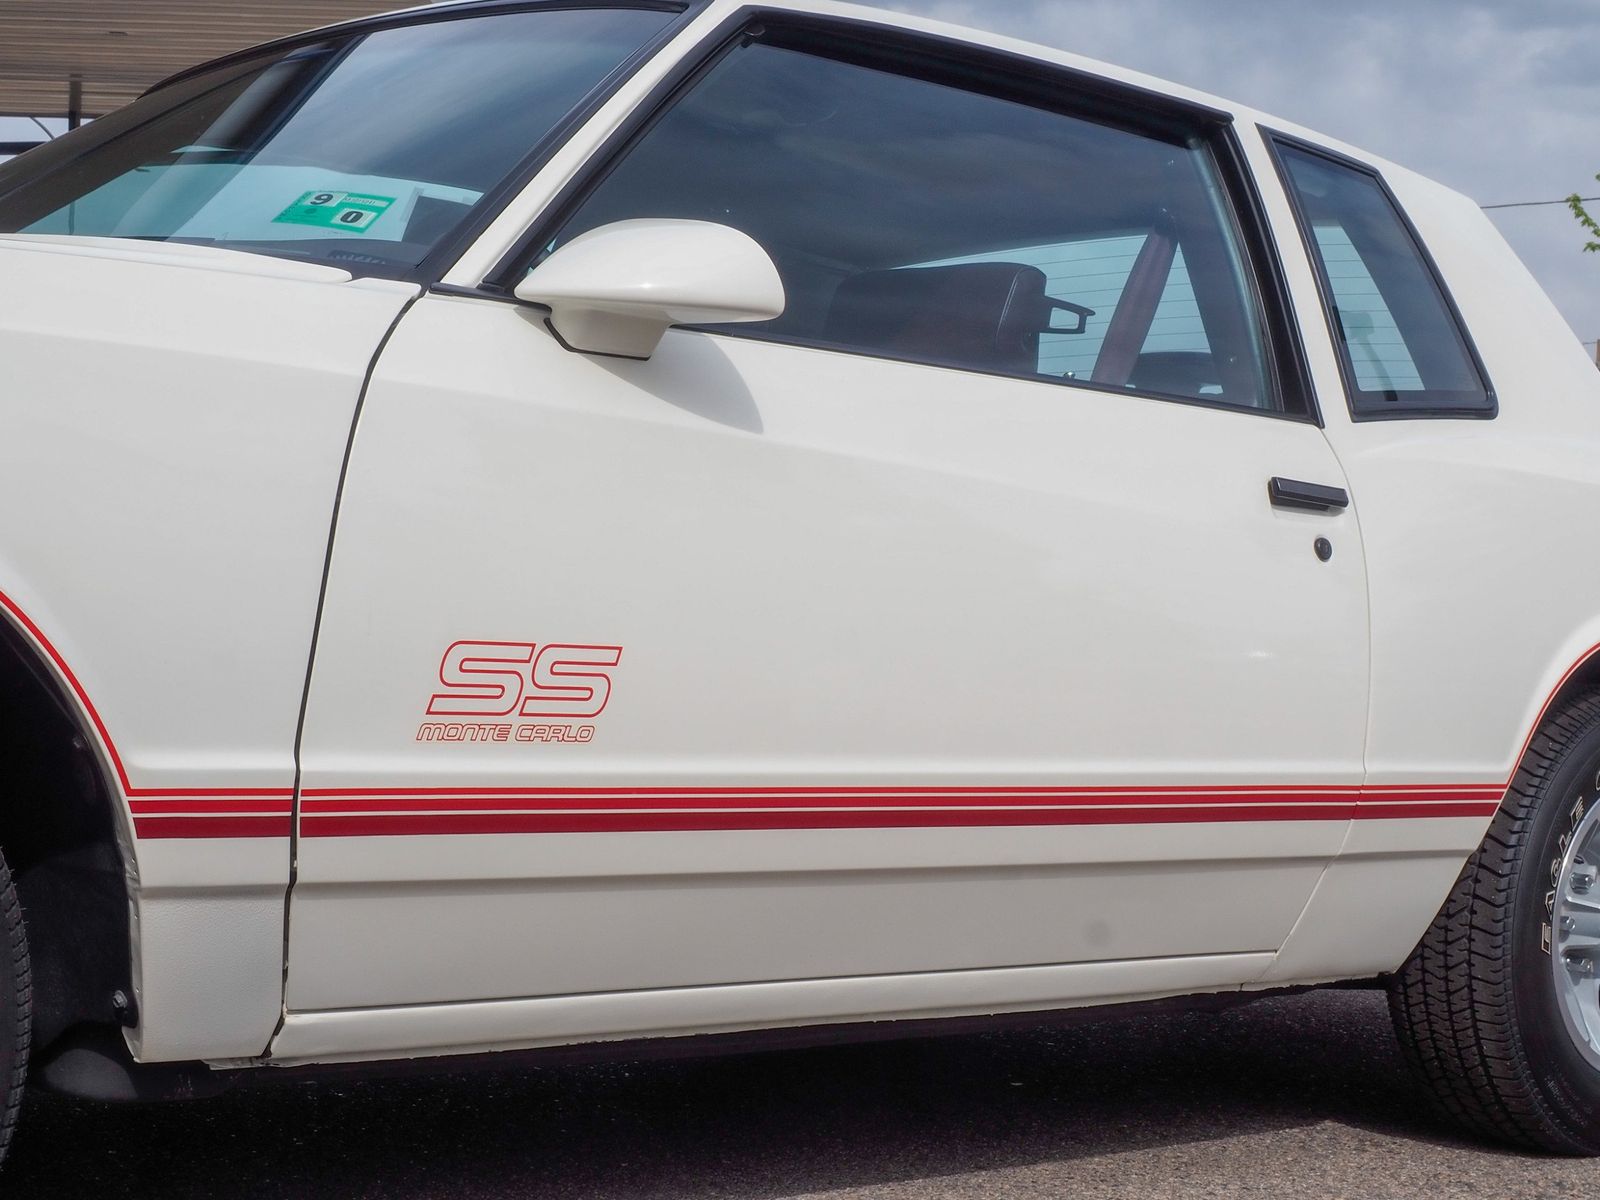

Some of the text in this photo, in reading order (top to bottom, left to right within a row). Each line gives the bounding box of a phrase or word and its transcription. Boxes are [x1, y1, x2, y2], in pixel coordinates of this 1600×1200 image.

[311, 193, 334, 206] 9
[426, 639, 623, 718] SS
[416, 722, 595, 743] MONTE CARLO
[1541, 796, 1584, 955] EAGLE
